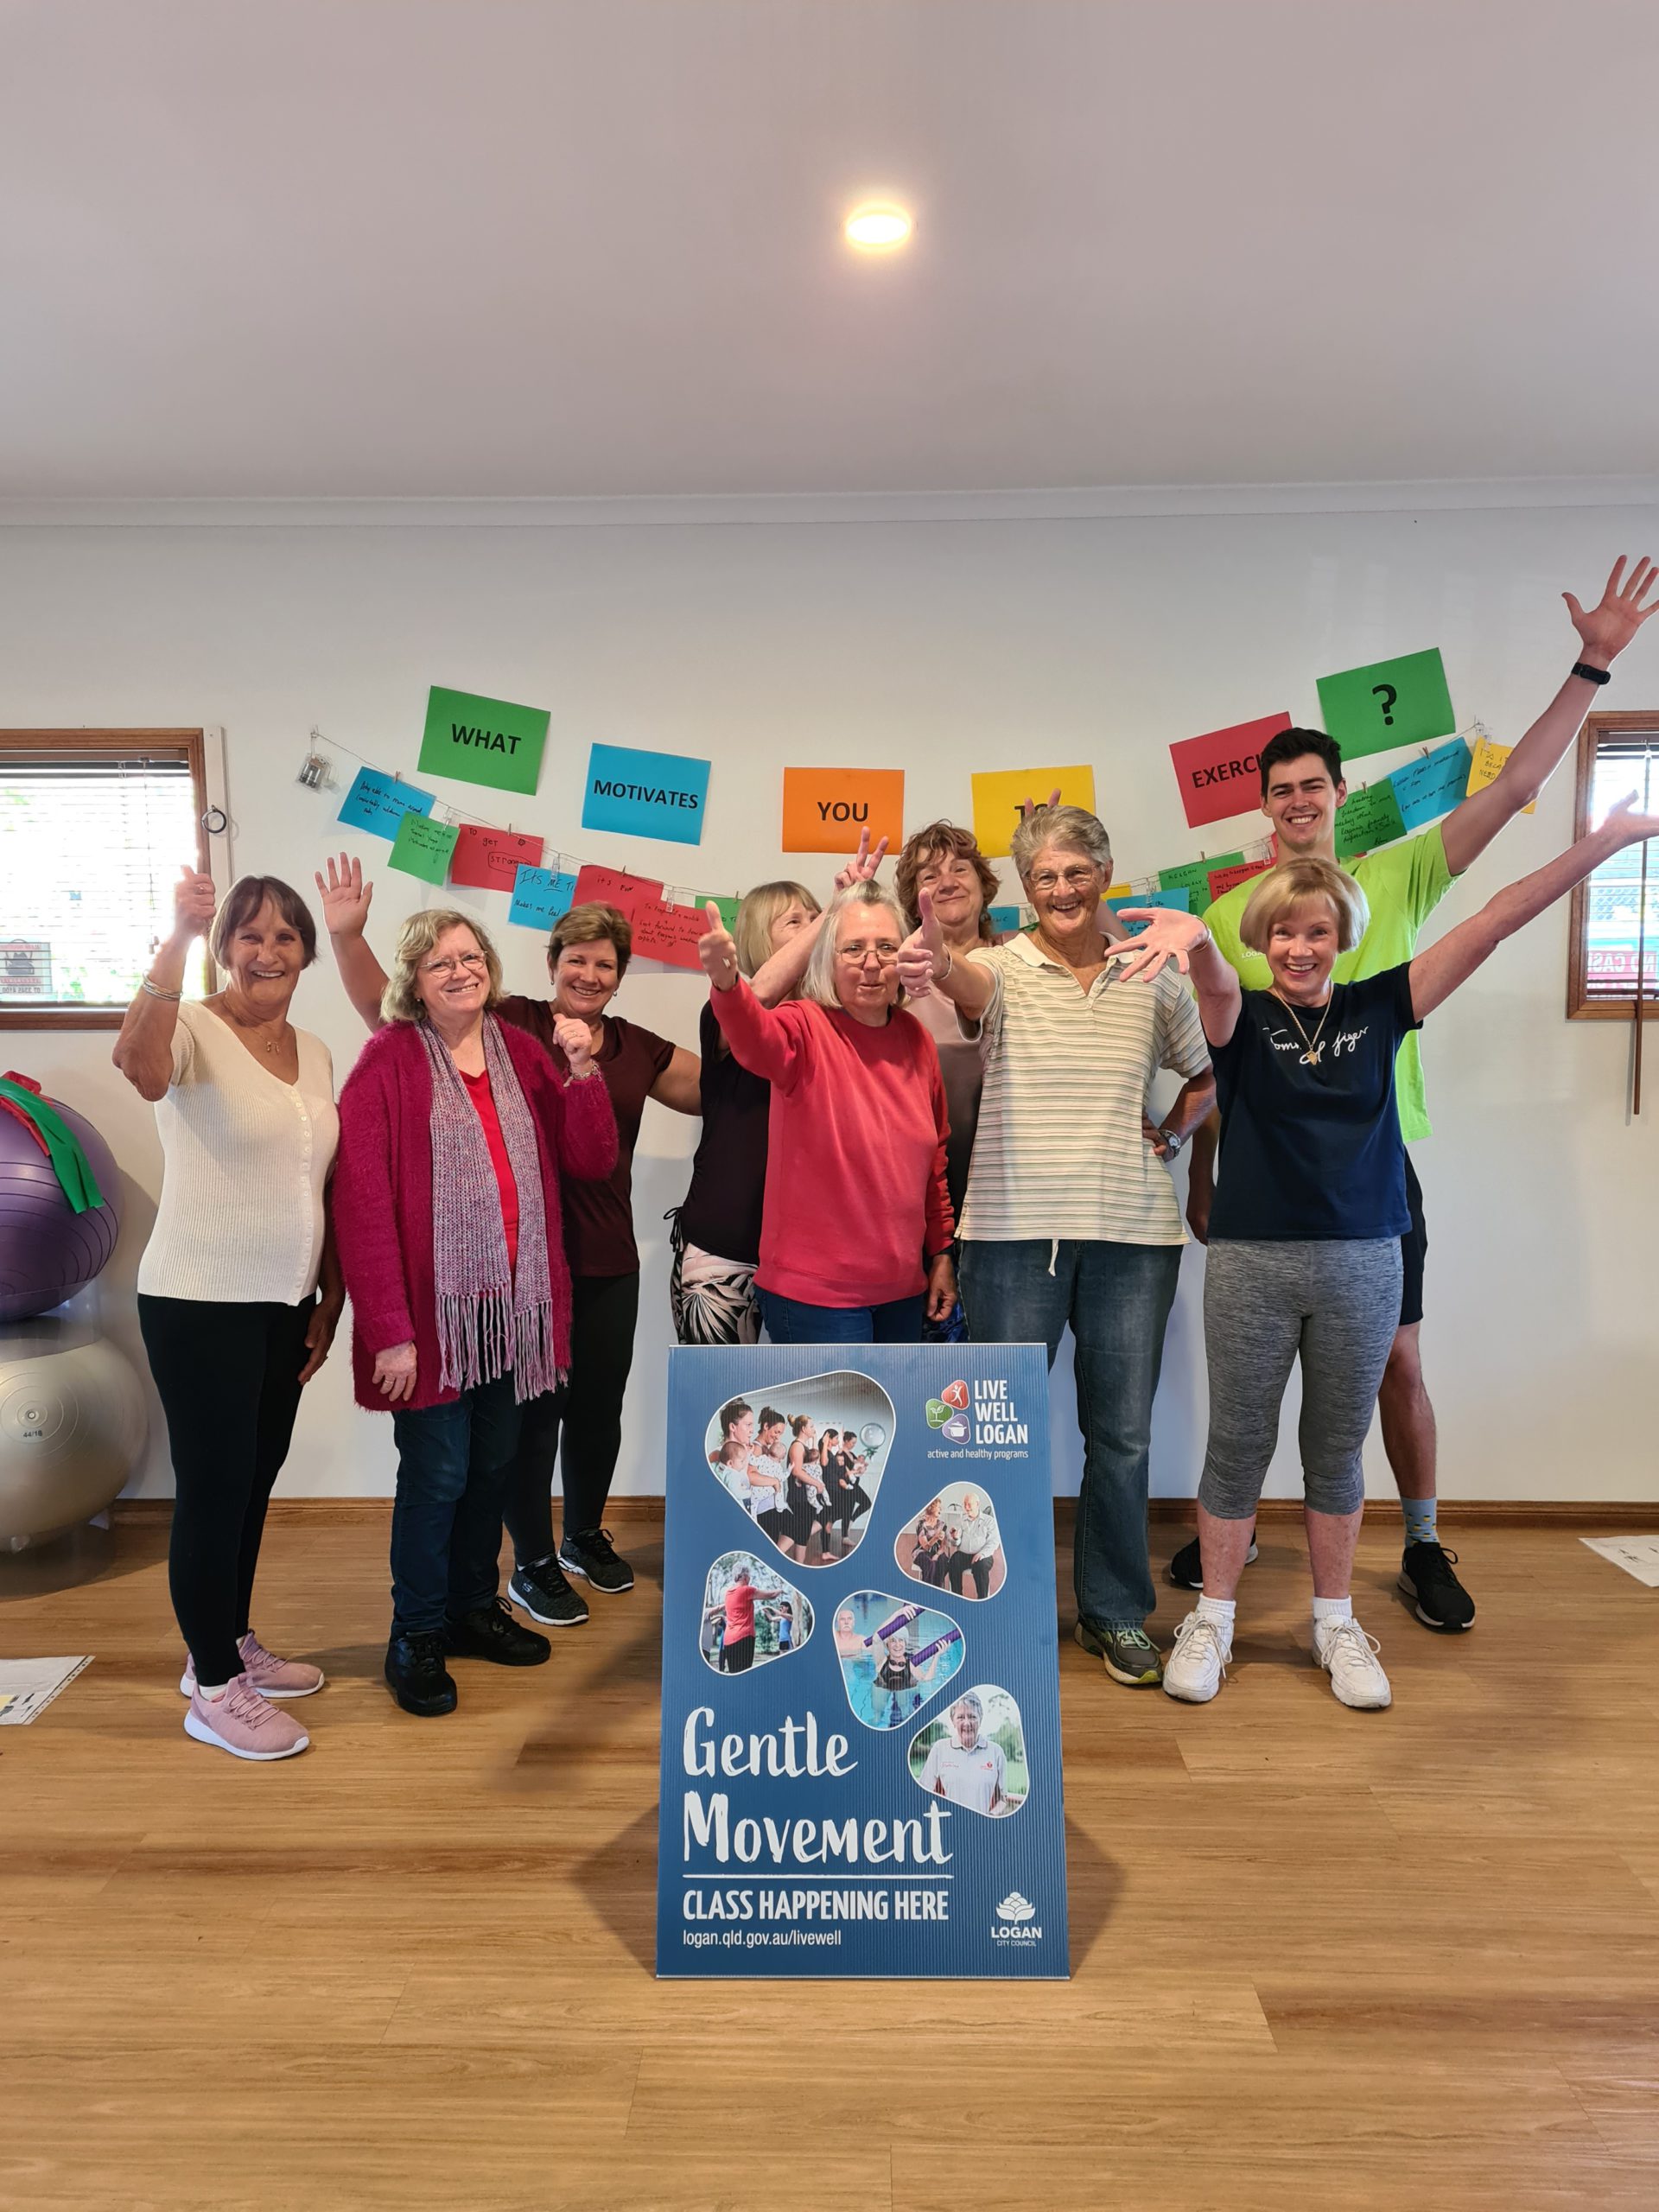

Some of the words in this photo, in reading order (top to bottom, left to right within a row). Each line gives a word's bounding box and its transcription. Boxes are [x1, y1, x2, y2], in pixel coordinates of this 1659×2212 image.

[1372, 684, 1397, 726] ?
[451, 723, 521, 754] WHAT
[1192, 755, 1262, 789] EXERCI
[593, 779, 698, 809] MOTIVATES
[817, 801, 868, 822] YOU
[974, 1379, 1008, 1400] LIVE
[974, 1402, 1019, 1422] WELL
[975, 1424, 1029, 1445] LOGAN
[927, 1448, 949, 1459] active
[950, 1449, 964, 1459] and
[965, 1449, 993, 1460] healthy
[994, 1451, 1029, 1460] programs
[683, 1706, 858, 1778] Gentle
[683, 1790, 954, 1865] Movement
[683, 1890, 753, 1920] CLASS
[759, 1890, 889, 1920] HAPPENING
[894, 1891, 949, 1920] HERE
[683, 1929, 842, 1948] logan.qld.gov.au/livewell
[990, 1926, 1043, 1939] LOGAN
